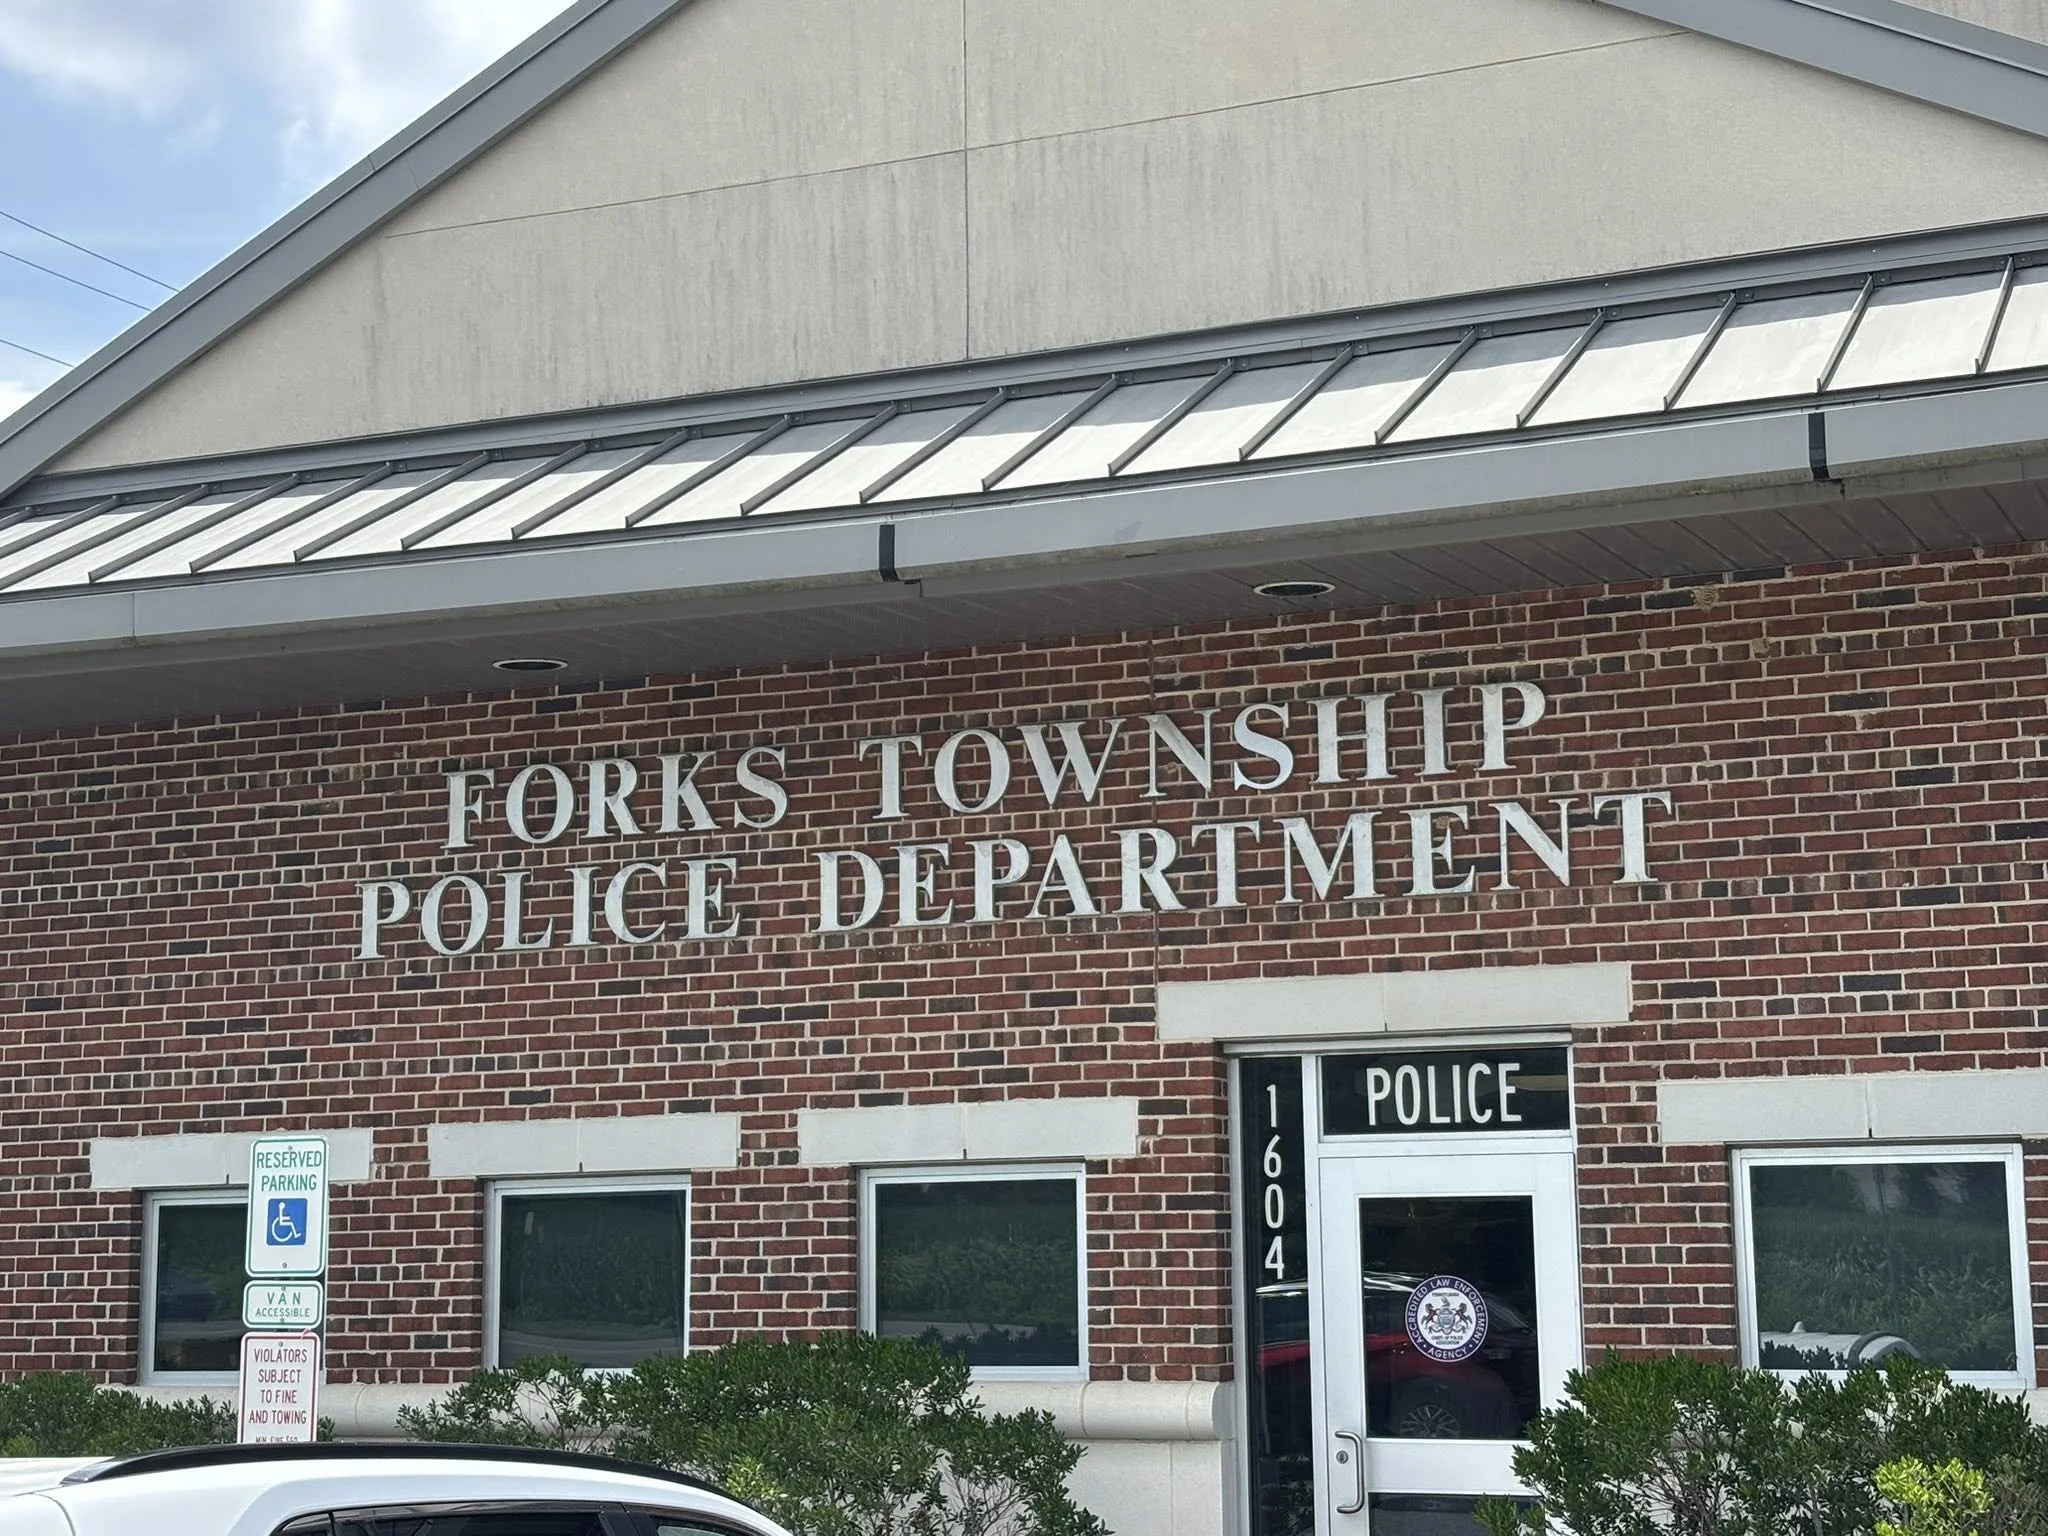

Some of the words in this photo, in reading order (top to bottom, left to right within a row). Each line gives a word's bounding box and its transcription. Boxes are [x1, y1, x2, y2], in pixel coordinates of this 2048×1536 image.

[440, 747, 788, 848] FORKS
[859, 682, 1545, 819] TOWNSHIP
[354, 857, 741, 960] POLICE
[811, 791, 1672, 932] DEPARTMENT
[1366, 1063, 1522, 1126] POLICE
[256, 1150, 322, 1169] RESERVED
[261, 1174, 317, 1192] PARKING
[1264, 1084, 1285, 1280] 1604
[267, 1292, 302, 1305] VAN
[255, 1307, 310, 1317] ACCESSIBLE
[1408, 1286, 1428, 1344] ACCREDITED
[1430, 1279, 1451, 1289] LAW
[1454, 1281, 1485, 1345] ENFORCEMENT
[253, 1348, 308, 1363] VIOLATORS
[1427, 1347, 1468, 1359] AGENCY
[258, 1369, 302, 1384] SUBJECT
[260, 1390, 273, 1404] TO
[275, 1389, 298, 1404] FINE
[249, 1410, 268, 1424] AND
[272, 1410, 307, 1424] TOWING
